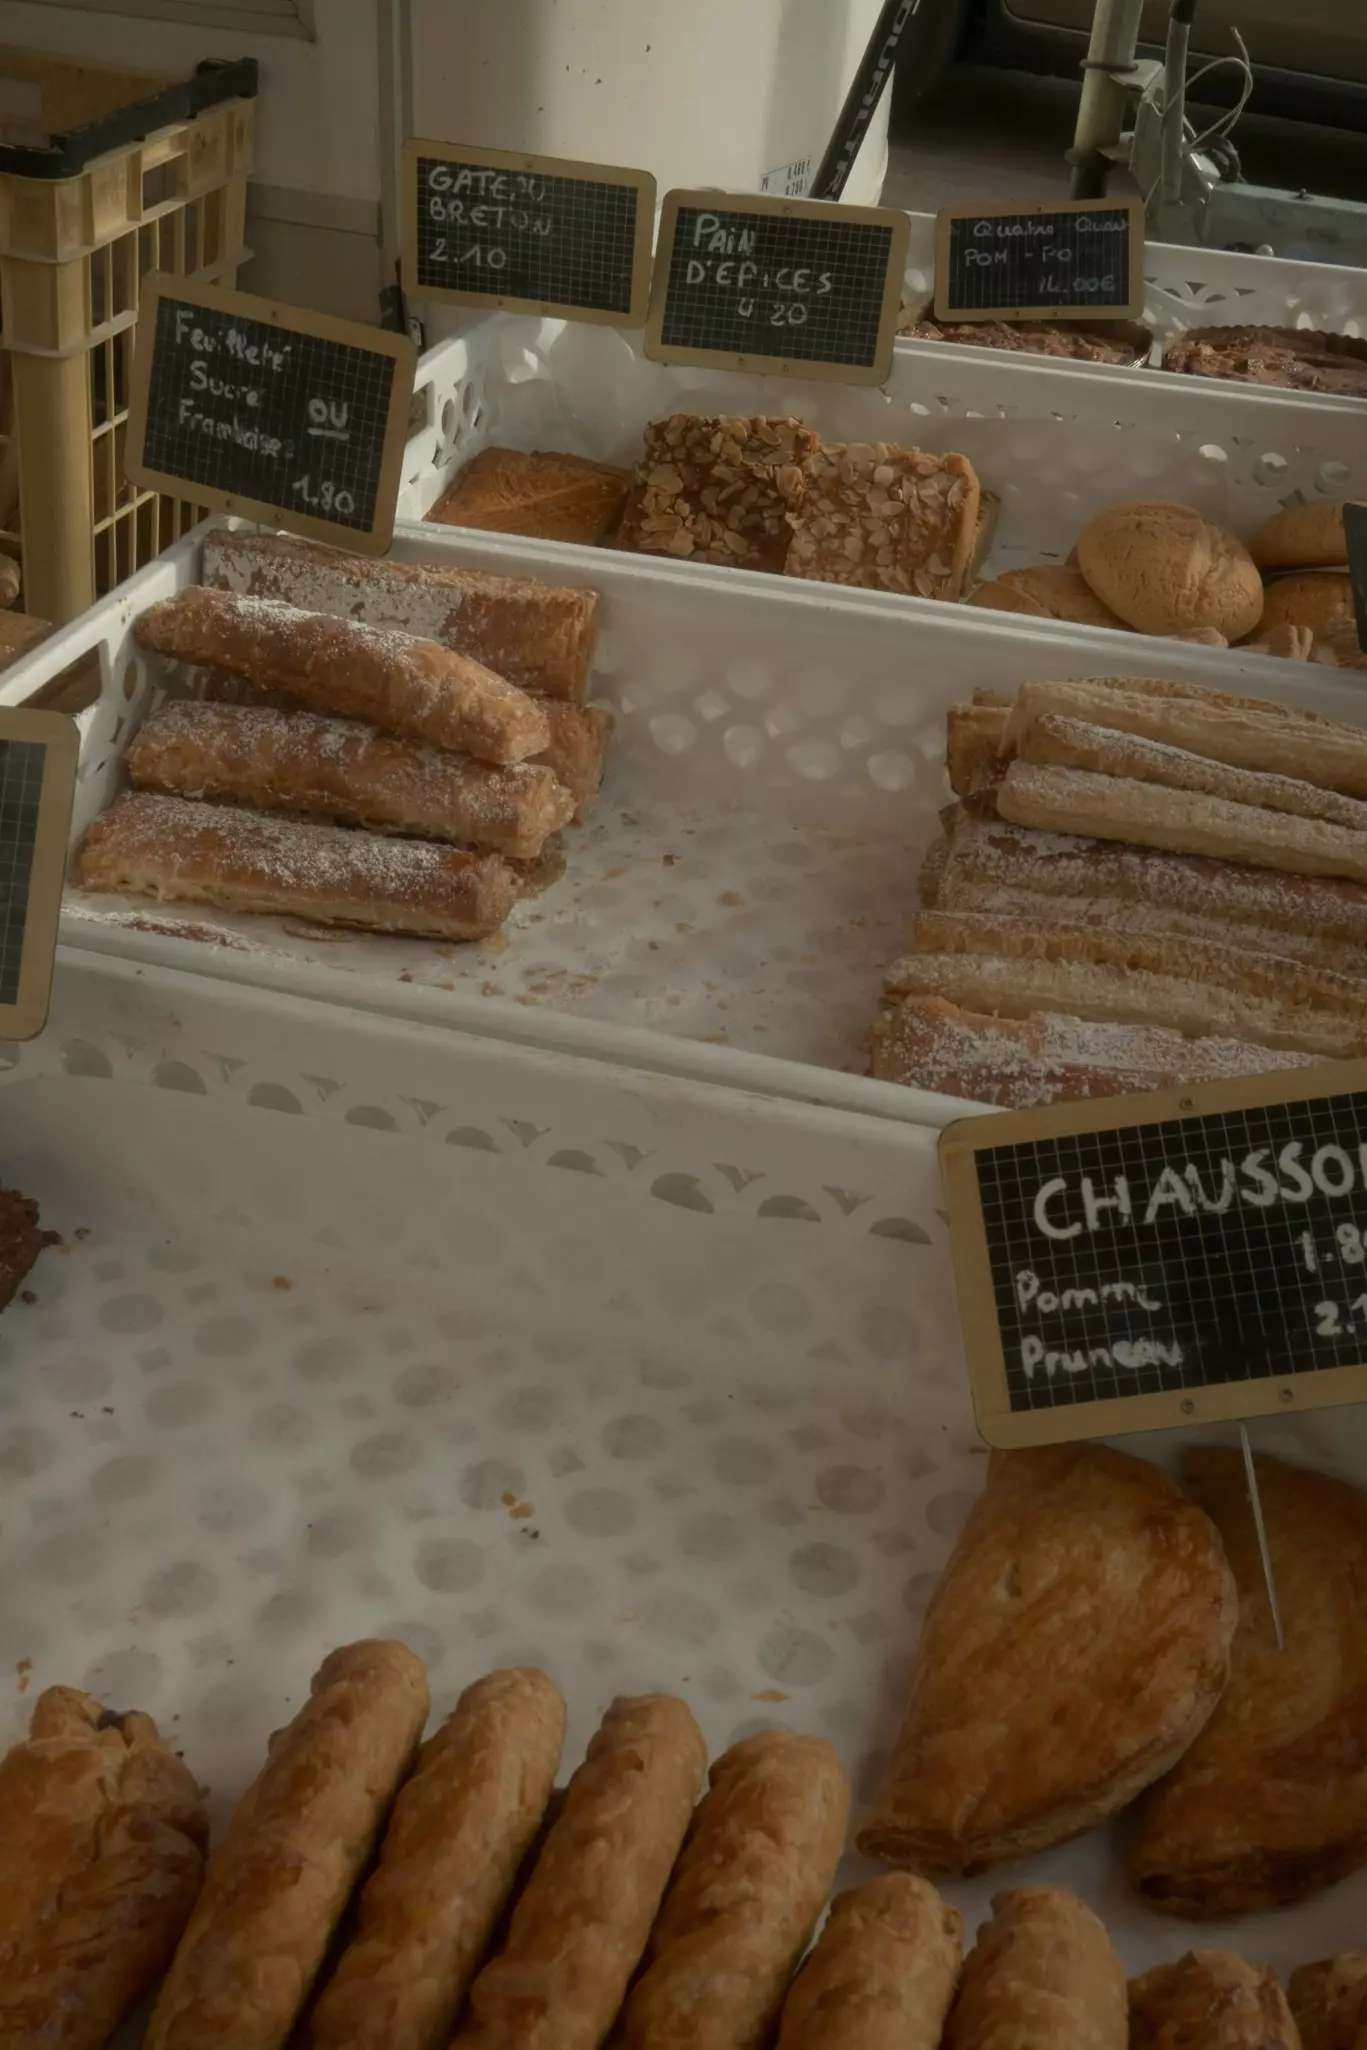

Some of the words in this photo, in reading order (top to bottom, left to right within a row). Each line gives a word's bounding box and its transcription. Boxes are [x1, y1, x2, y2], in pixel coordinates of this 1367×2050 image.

[429, 197, 551, 236] BRETON
[429, 238, 507, 269] 2.10
[964, 248, 1009, 268] POM
[769, 302, 809, 327] 20
[308, 398, 350, 429] OU
[292, 474, 356, 515] 1.80
[1295, 1221, 1367, 1274] 1.8
[1015, 1268, 1162, 1313] Pomme
